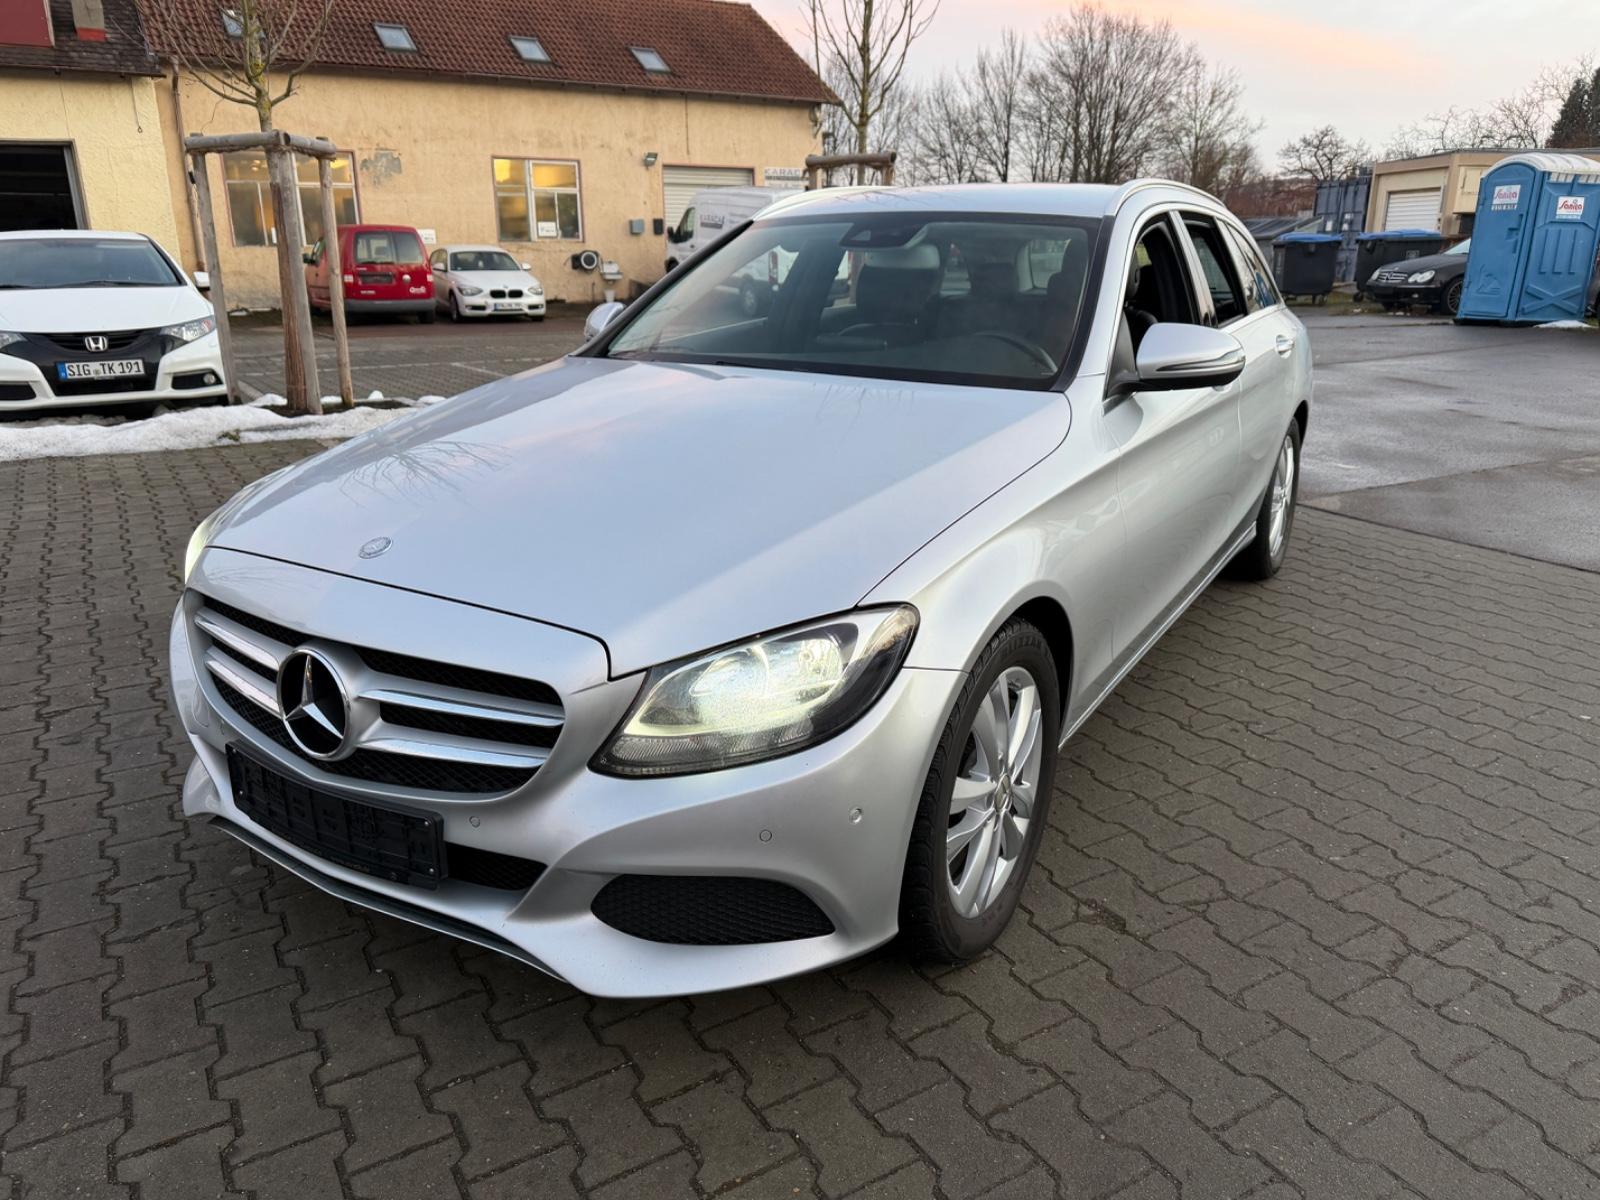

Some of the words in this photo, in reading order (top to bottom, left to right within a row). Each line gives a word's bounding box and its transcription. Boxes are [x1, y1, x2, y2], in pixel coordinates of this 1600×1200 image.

[67, 363, 91, 377] SIG
[99, 362, 117, 375] TK
[118, 361, 142, 374] 191
